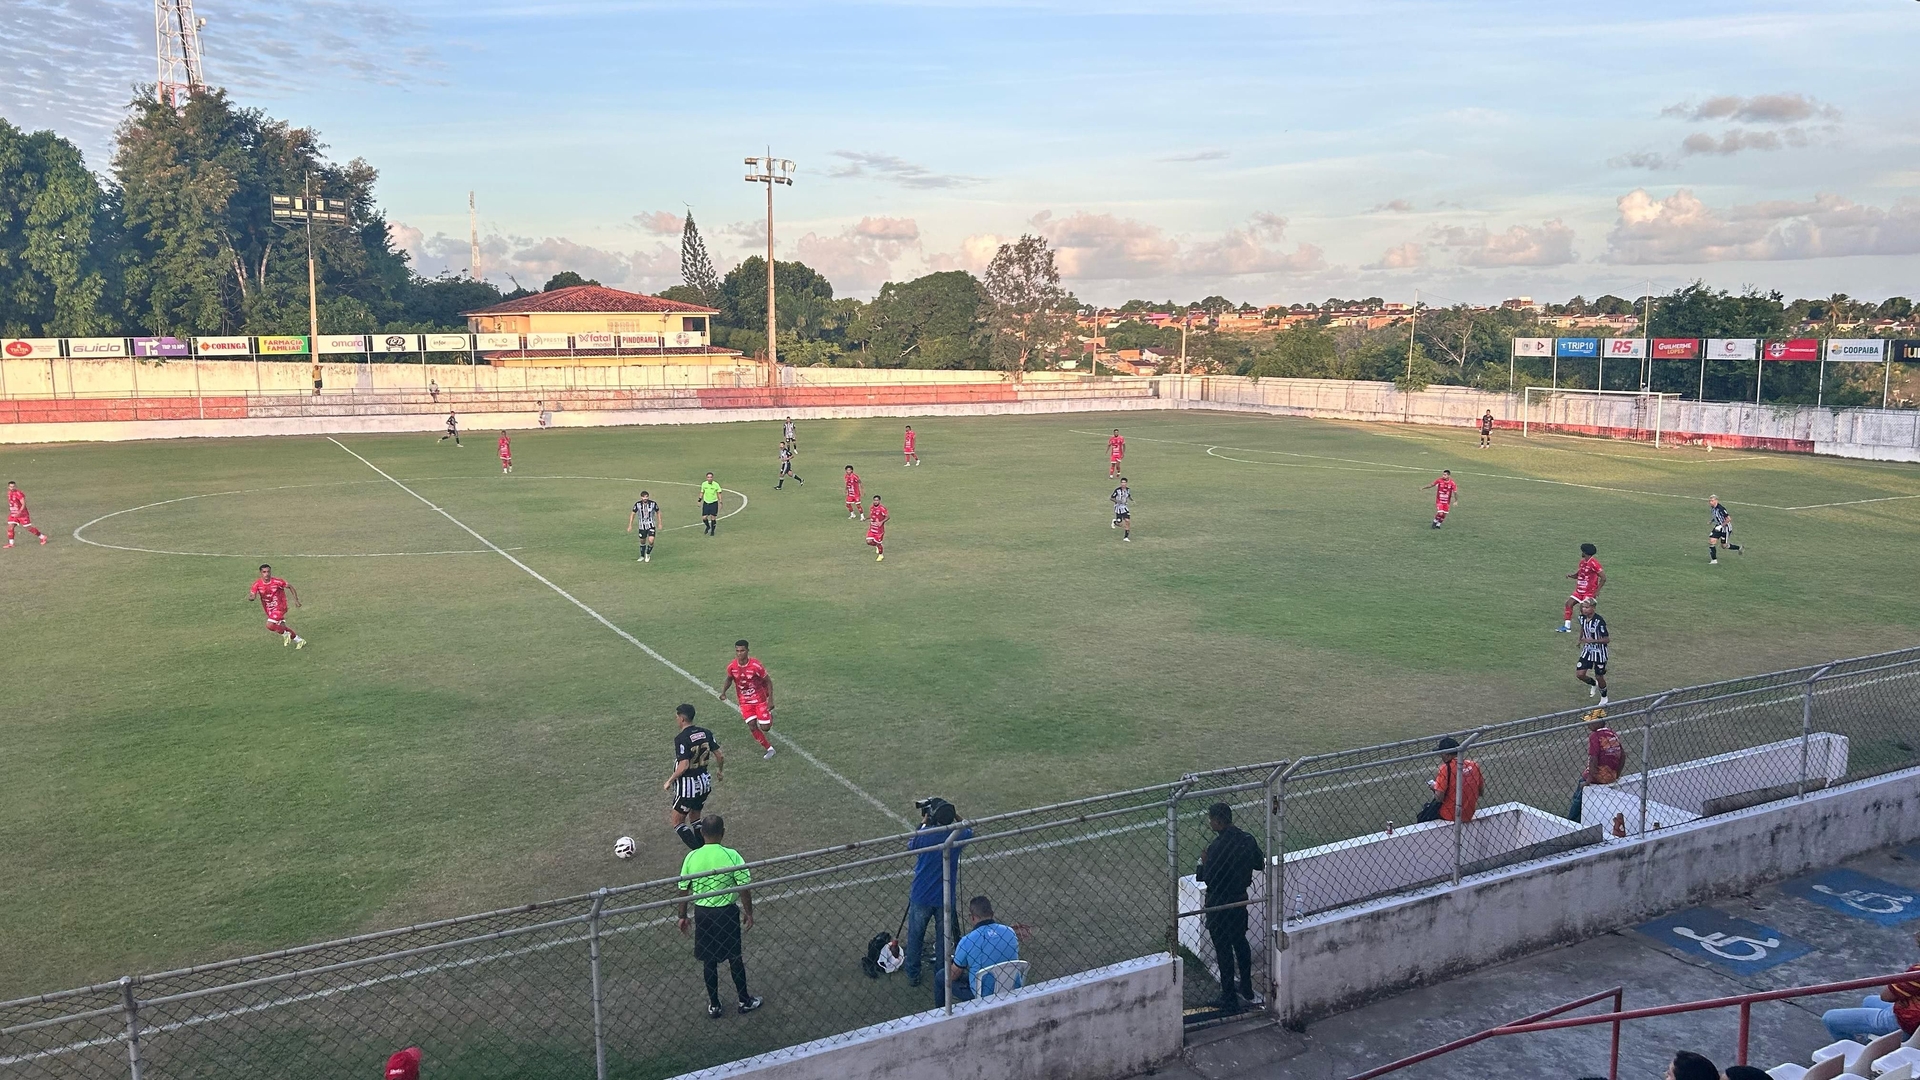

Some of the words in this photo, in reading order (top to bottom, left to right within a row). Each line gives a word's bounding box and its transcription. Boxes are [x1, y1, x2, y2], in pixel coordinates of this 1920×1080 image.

[590, 334, 611, 342] fatal
[622, 336, 657, 344] PINDORAMA
[211, 342, 247, 350] CORINGA
[1567, 342, 1594, 350] TRIP10
[1611, 340, 1633, 353] RS
[1843, 346, 1878, 354] COOPAIBA
[690, 742, 711, 769] 22
